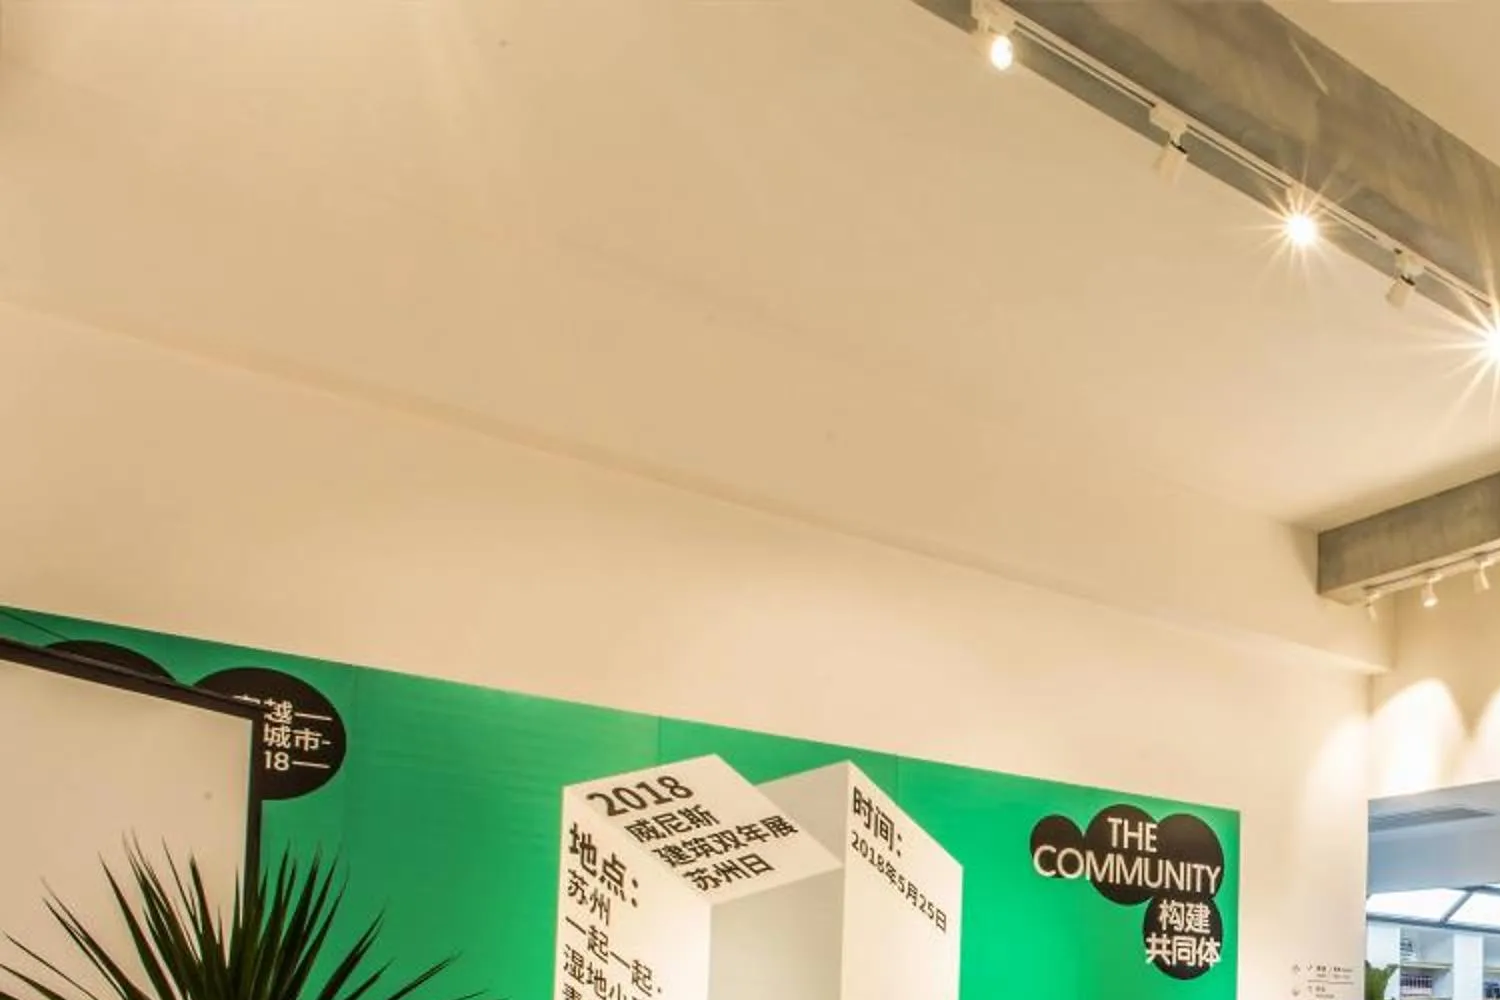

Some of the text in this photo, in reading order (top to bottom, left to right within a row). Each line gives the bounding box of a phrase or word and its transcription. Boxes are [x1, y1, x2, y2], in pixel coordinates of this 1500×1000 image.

[586, 775, 694, 817] 2018
[624, 804, 720, 843] 威尼斯
[652, 815, 799, 868] 建筑双年展
[1107, 817, 1158, 853] THE
[683, 853, 775, 891] 苏州日
[851, 830, 947, 933] 2018年5月25日
[1033, 845, 1221, 895] COMMUNITY
[567, 868, 611, 926] 苏州
[1158, 899, 1211, 934] 构建
[1146, 932, 1222, 968] 共同体
